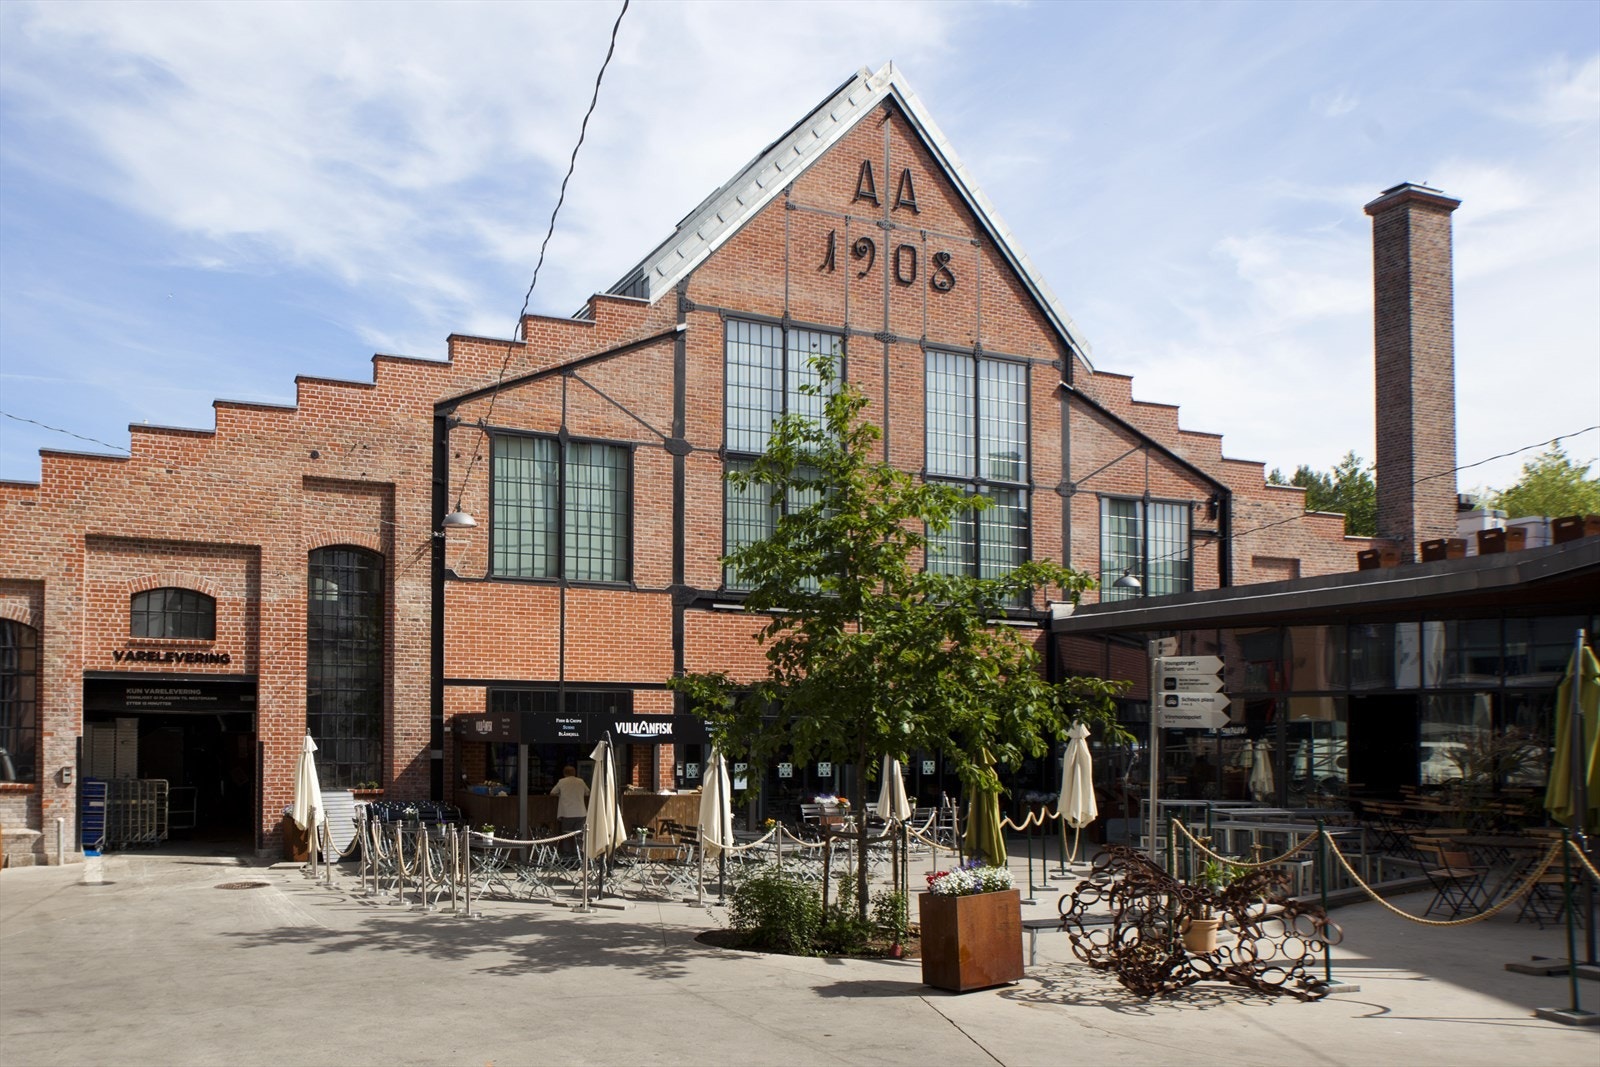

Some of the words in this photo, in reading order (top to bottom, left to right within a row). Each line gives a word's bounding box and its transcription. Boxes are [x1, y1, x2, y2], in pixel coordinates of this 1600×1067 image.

[817, 229, 956, 292] 1908
[113, 650, 231, 665] VARELEVERING
[615, 720, 673, 735] VULKANFISK
